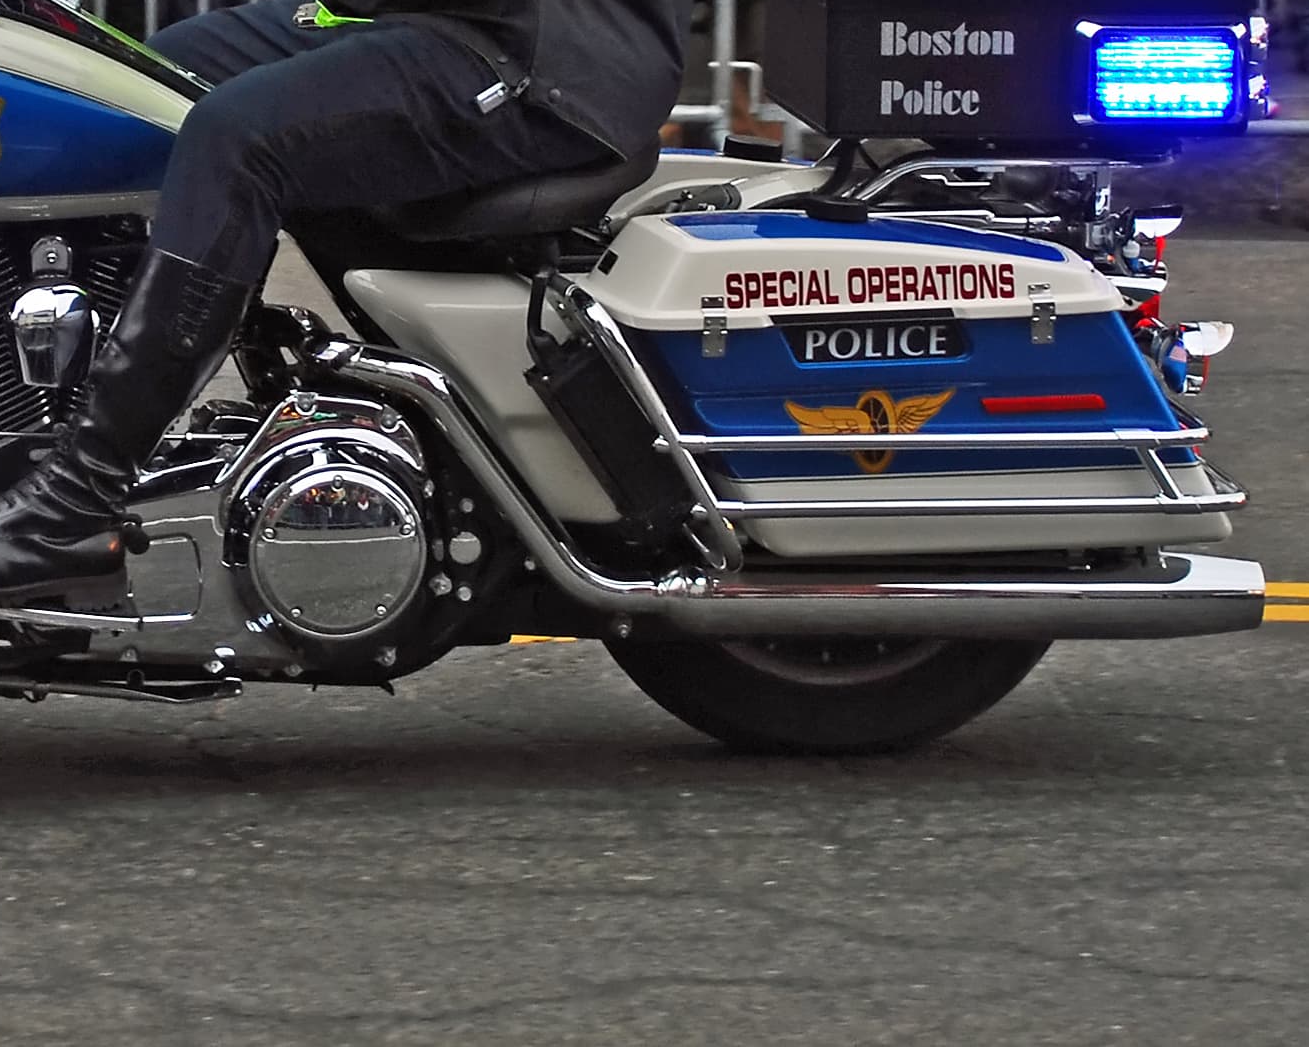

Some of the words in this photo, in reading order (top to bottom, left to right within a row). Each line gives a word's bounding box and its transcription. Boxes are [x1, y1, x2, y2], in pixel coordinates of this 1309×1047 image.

[880, 21, 1015, 56] Boston
[880, 80, 981, 116] Police
[725, 269, 839, 309] SPECIAL
[847, 263, 1015, 304] OPERATIONS
[804, 324, 947, 360] POLICE
